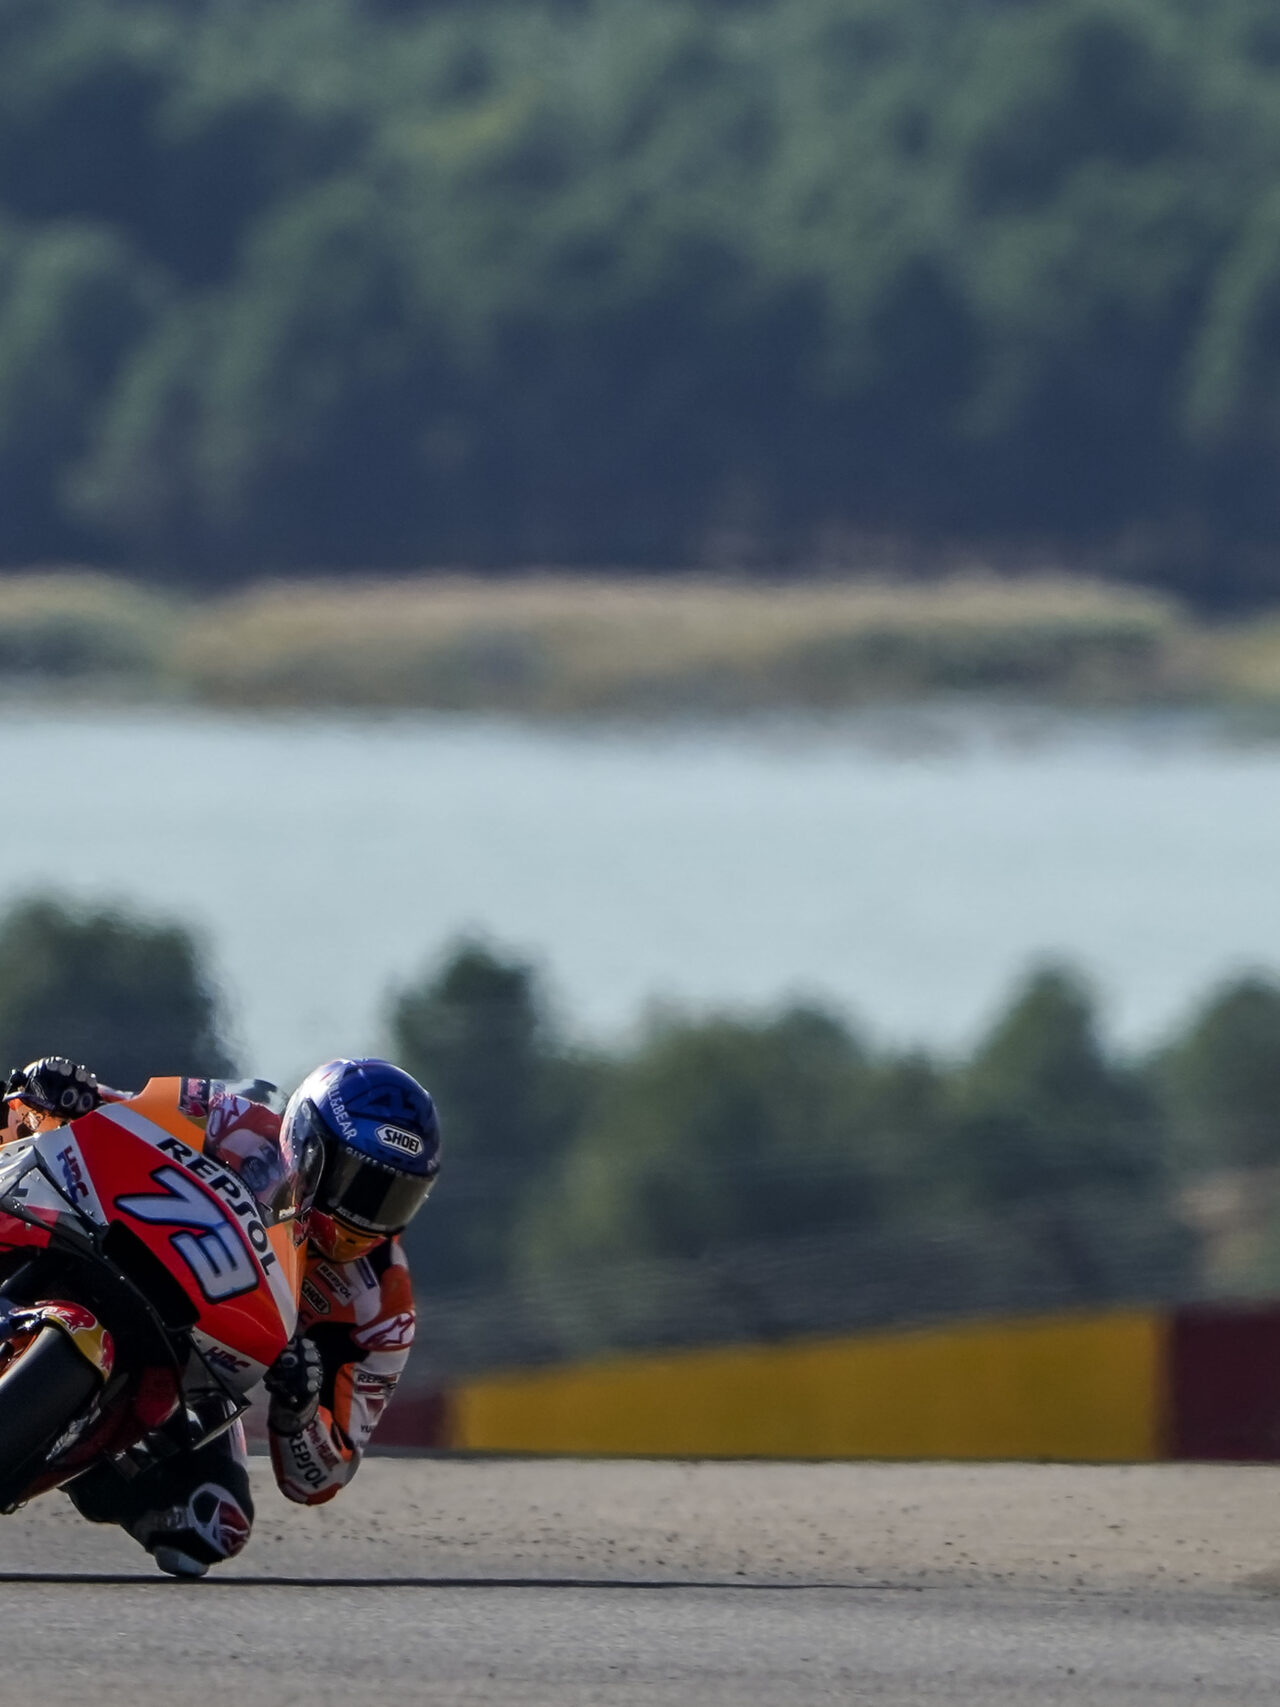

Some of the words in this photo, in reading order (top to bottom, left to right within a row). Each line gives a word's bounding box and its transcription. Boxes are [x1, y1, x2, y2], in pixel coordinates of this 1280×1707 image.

[327, 1082, 358, 1141] LL&BEAR
[383, 1128, 420, 1155] SHOEI
[113, 1164, 261, 1305] 73
[157, 1137, 277, 1277] REPSOL
[319, 1264, 352, 1299] REPSOL
[289, 1431, 328, 1490] REPSOL
